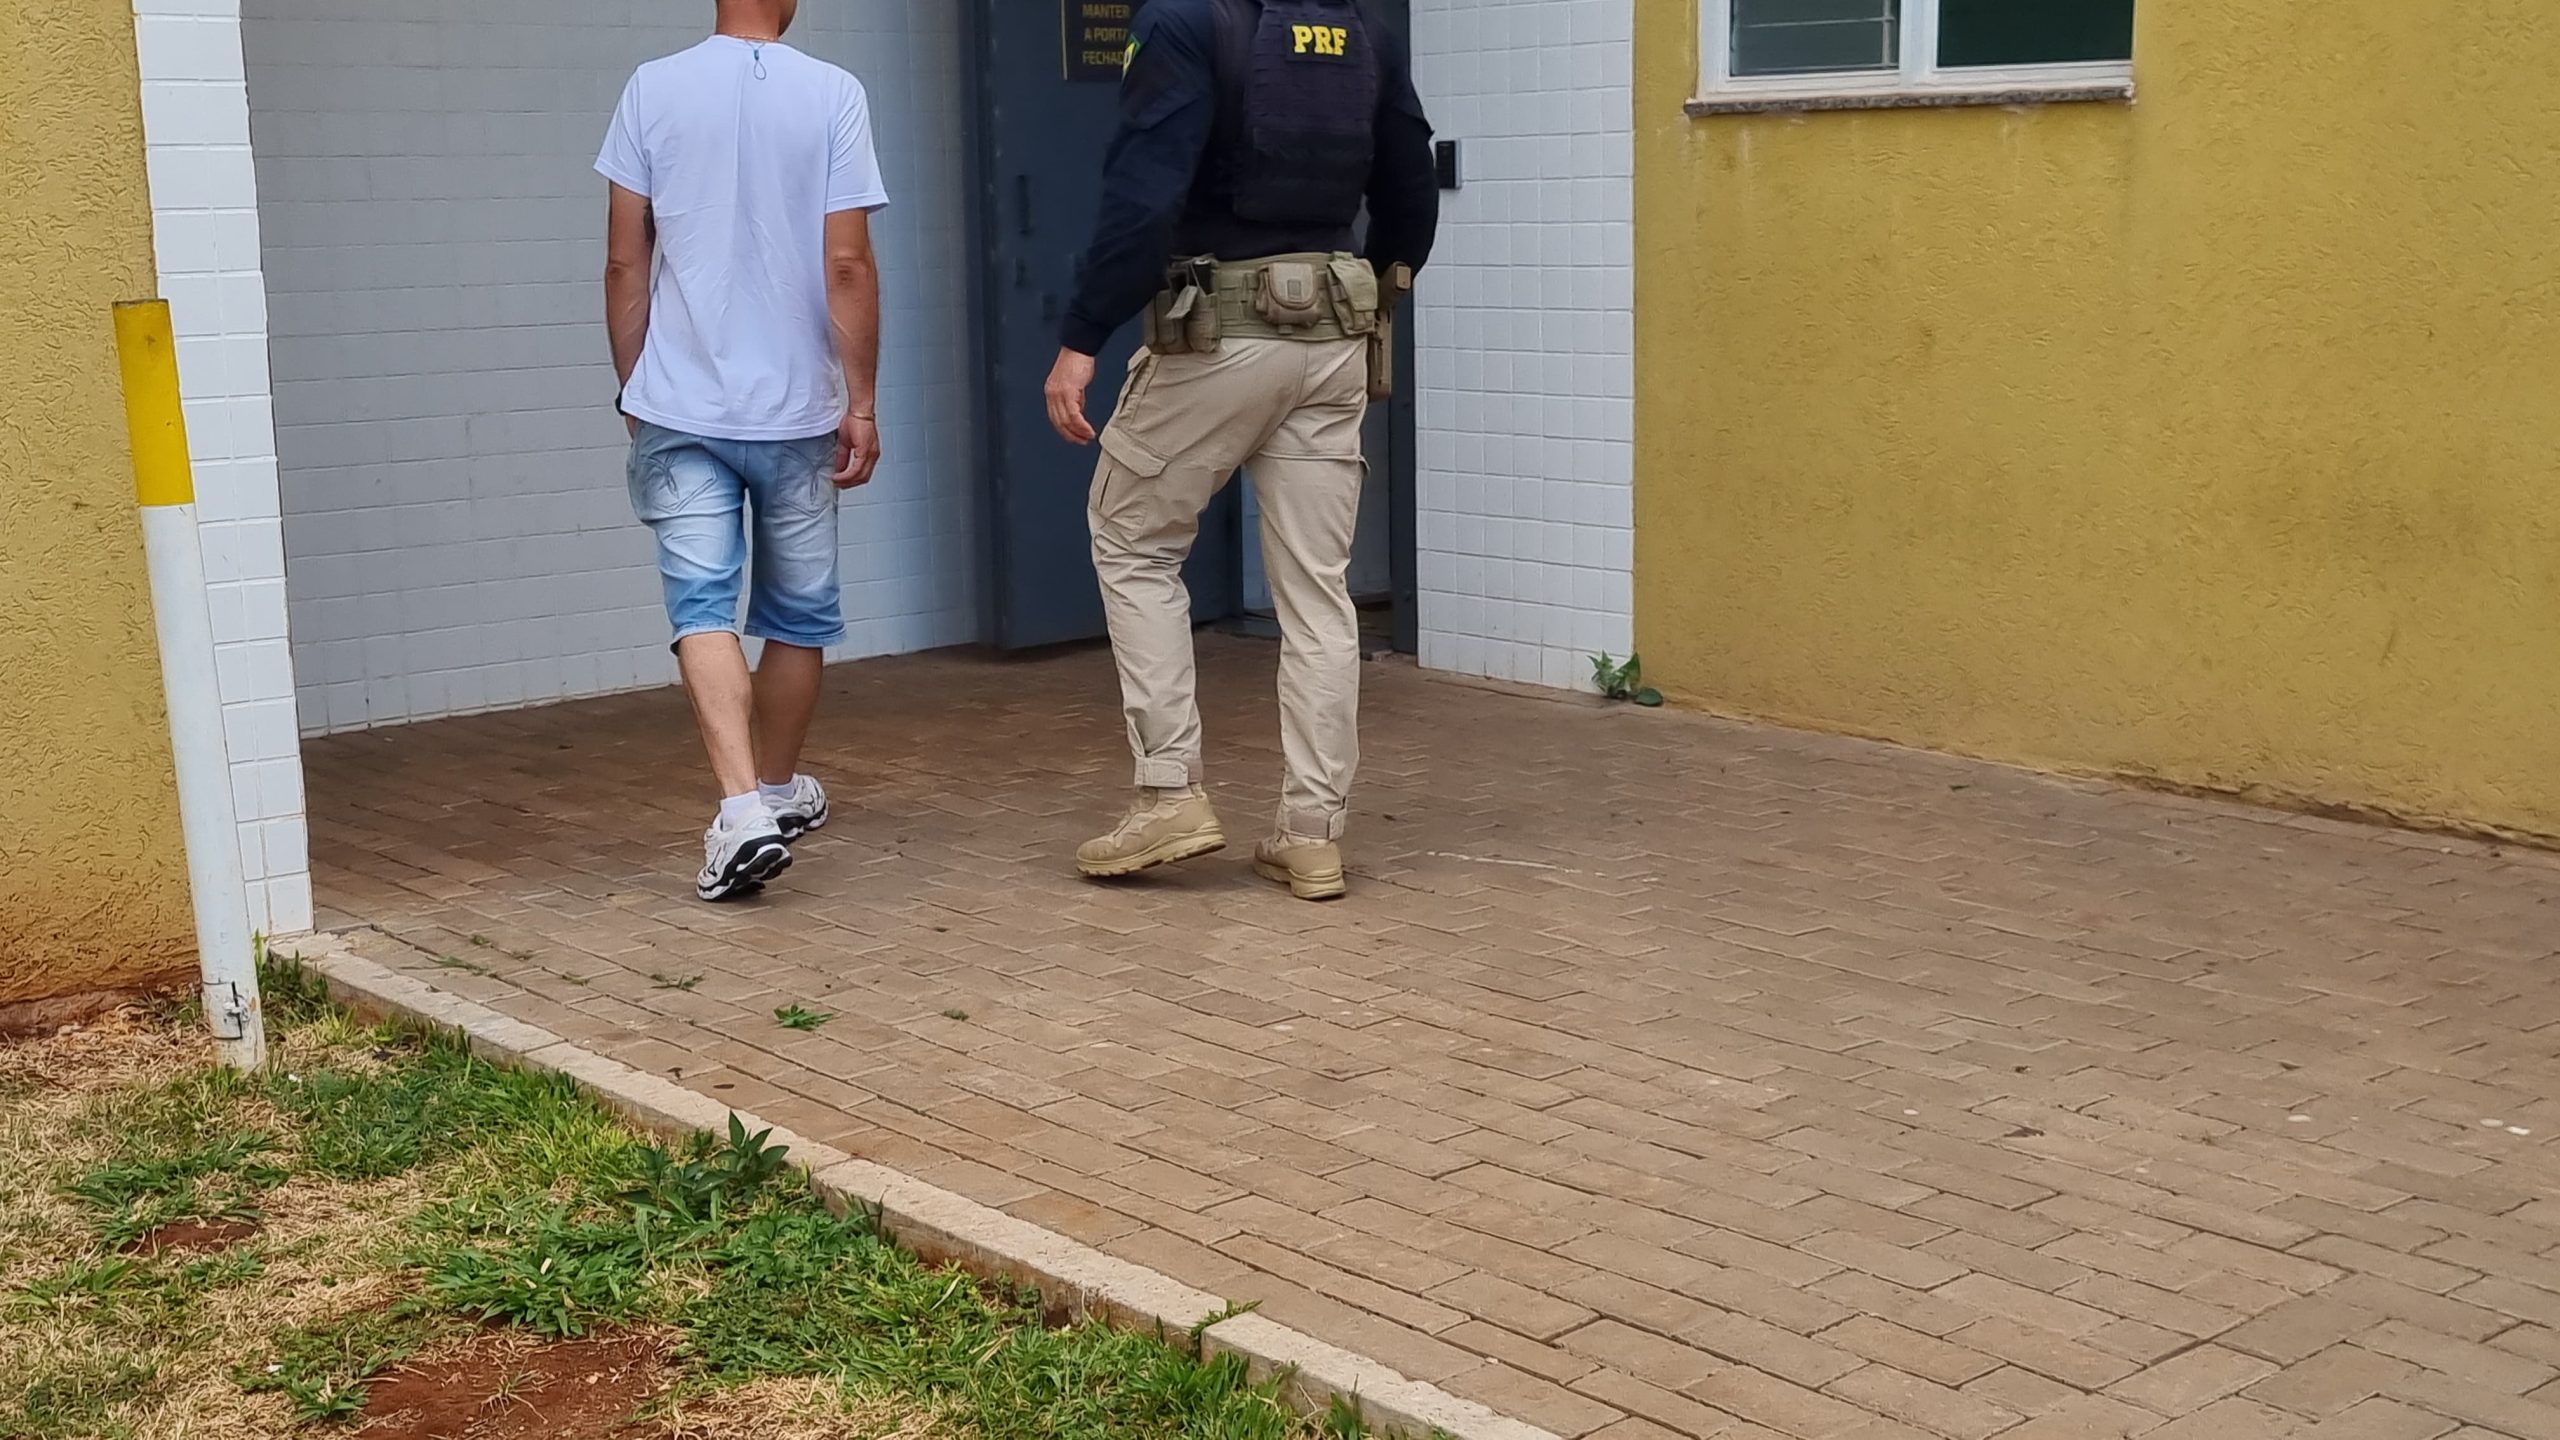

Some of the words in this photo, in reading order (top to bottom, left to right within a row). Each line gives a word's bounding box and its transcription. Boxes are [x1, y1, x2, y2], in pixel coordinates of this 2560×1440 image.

[1082, 4, 1130, 18] MANTER
[1084, 27, 1093, 41] A
[1291, 24, 1347, 56] PRF
[1082, 50, 1125, 64] FECHAD
